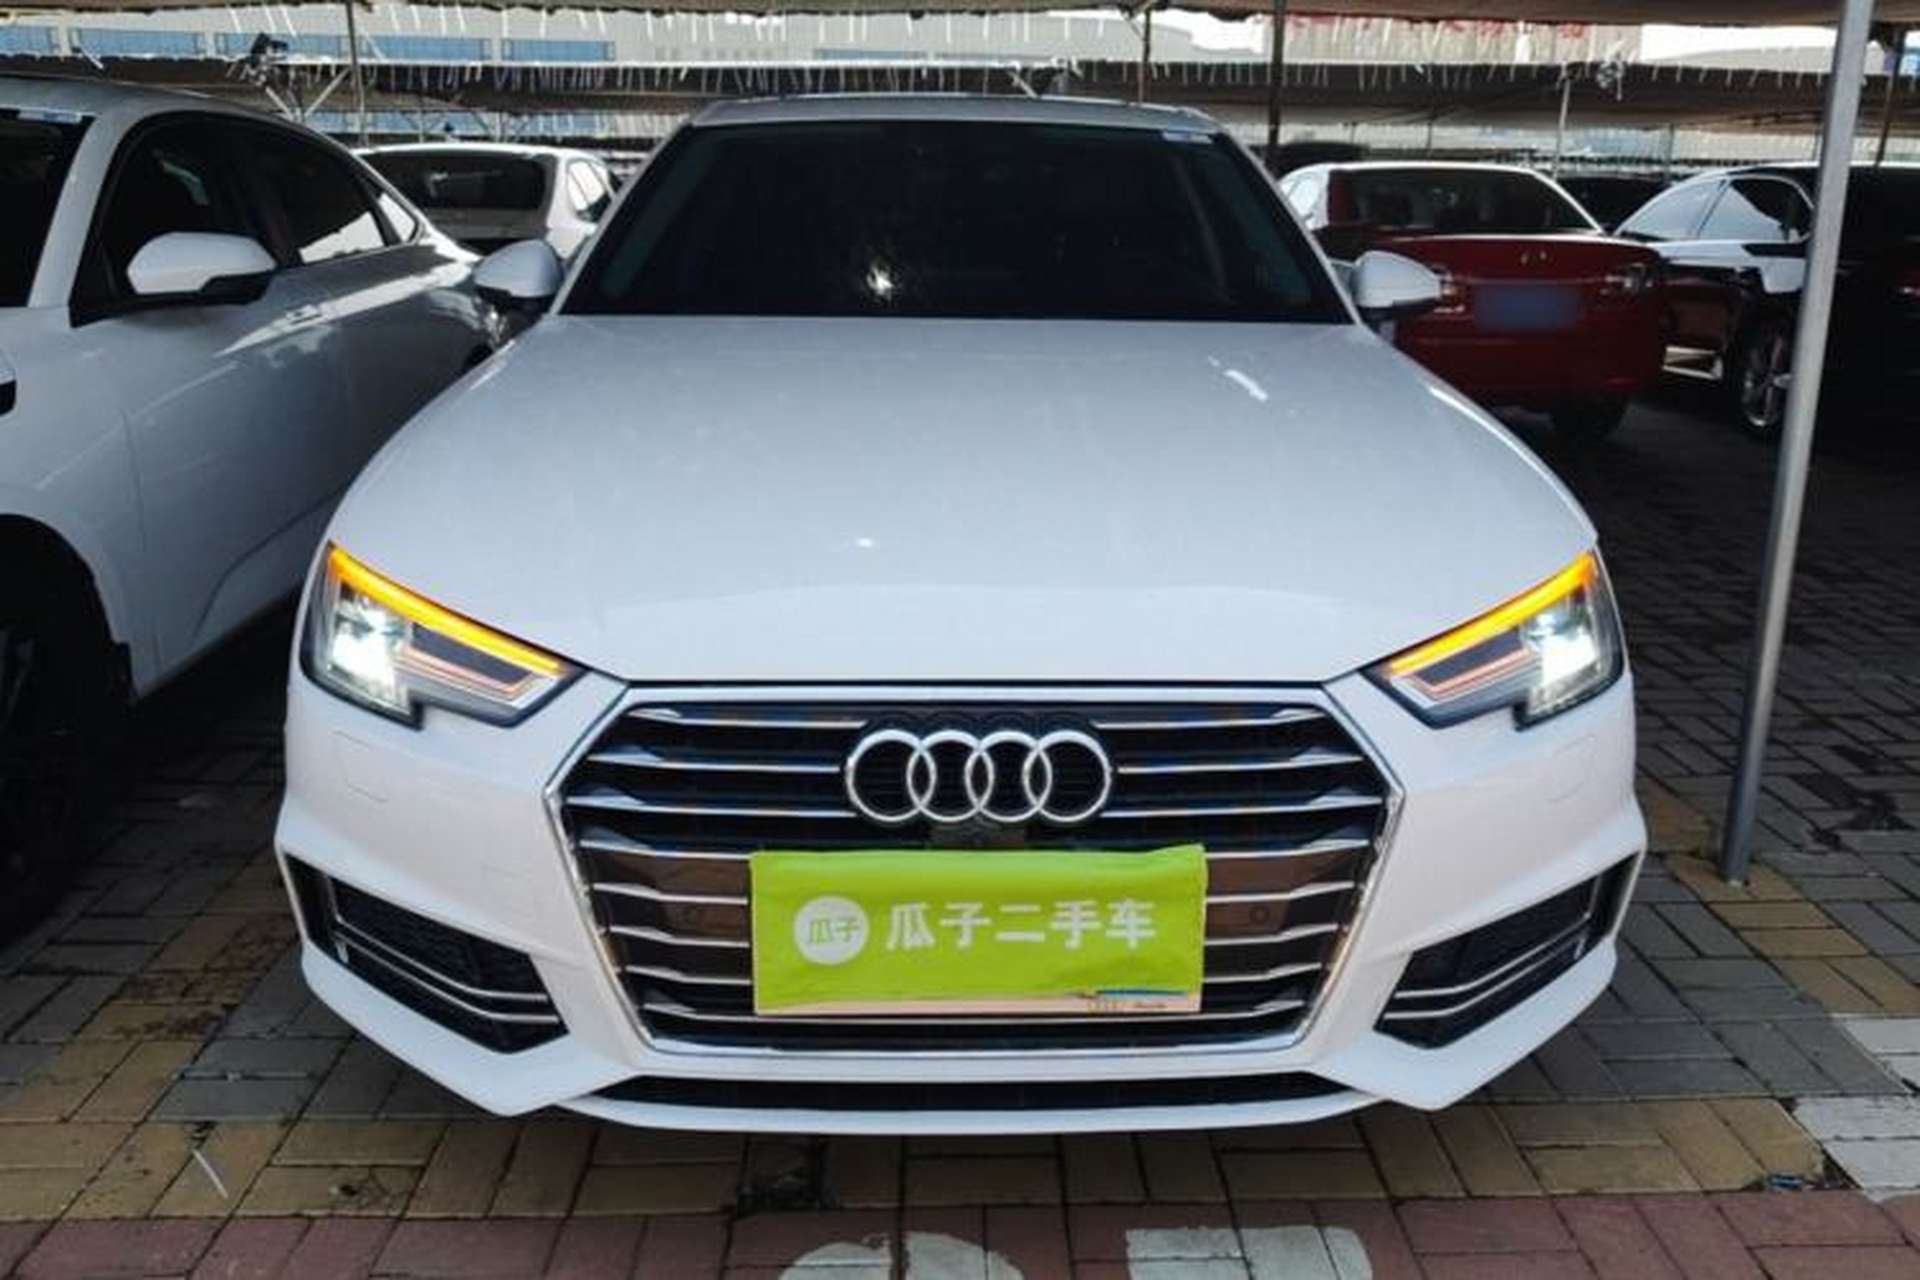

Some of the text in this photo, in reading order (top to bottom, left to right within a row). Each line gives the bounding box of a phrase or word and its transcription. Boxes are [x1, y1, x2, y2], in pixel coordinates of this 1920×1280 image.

[809, 919, 860, 944] 瓜子
[886, 900, 1156, 950] 瓜子二手车
